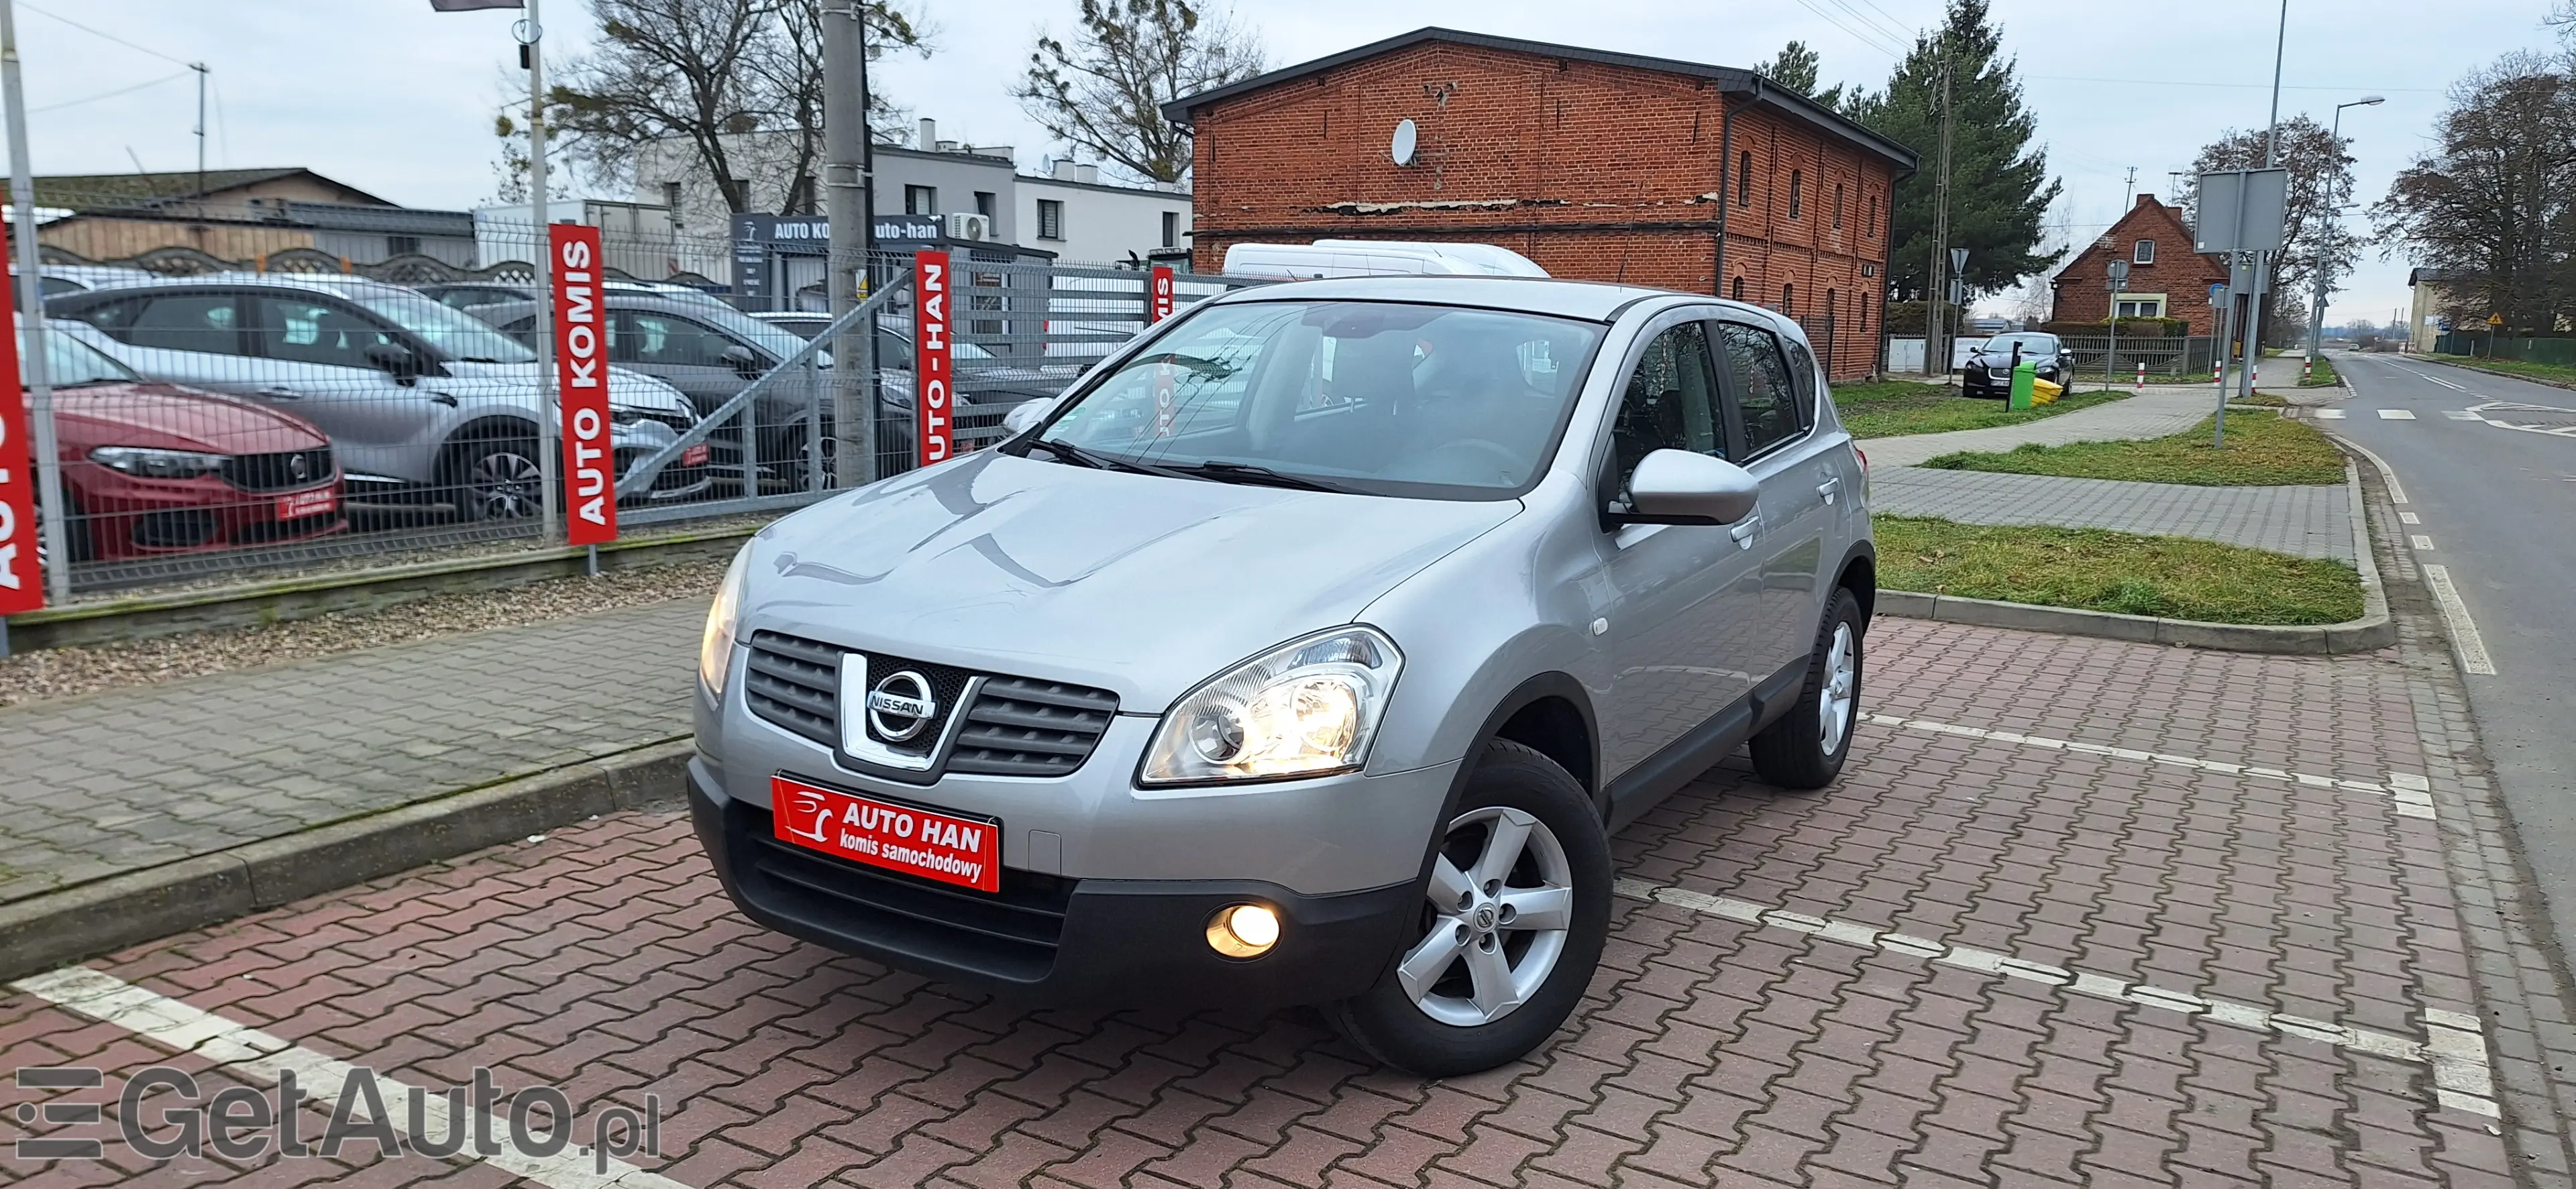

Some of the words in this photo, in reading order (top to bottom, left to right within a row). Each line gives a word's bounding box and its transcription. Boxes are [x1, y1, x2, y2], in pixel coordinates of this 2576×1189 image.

[774, 223, 809, 239] AUTO
[875, 222, 937, 239] uto-han
[563, 240, 597, 388] KOMIS
[924, 264, 943, 349] HAN
[928, 380, 945, 460] UTO
[1160, 389, 1170, 437] UTO
[574, 407, 606, 525] AUTO
[871, 695, 924, 715] NISSAN
[842, 802, 914, 837] AUTO
[921, 819, 981, 853] HAN
[839, 828, 879, 855] komis
[881, 842, 982, 883] samochodowy
